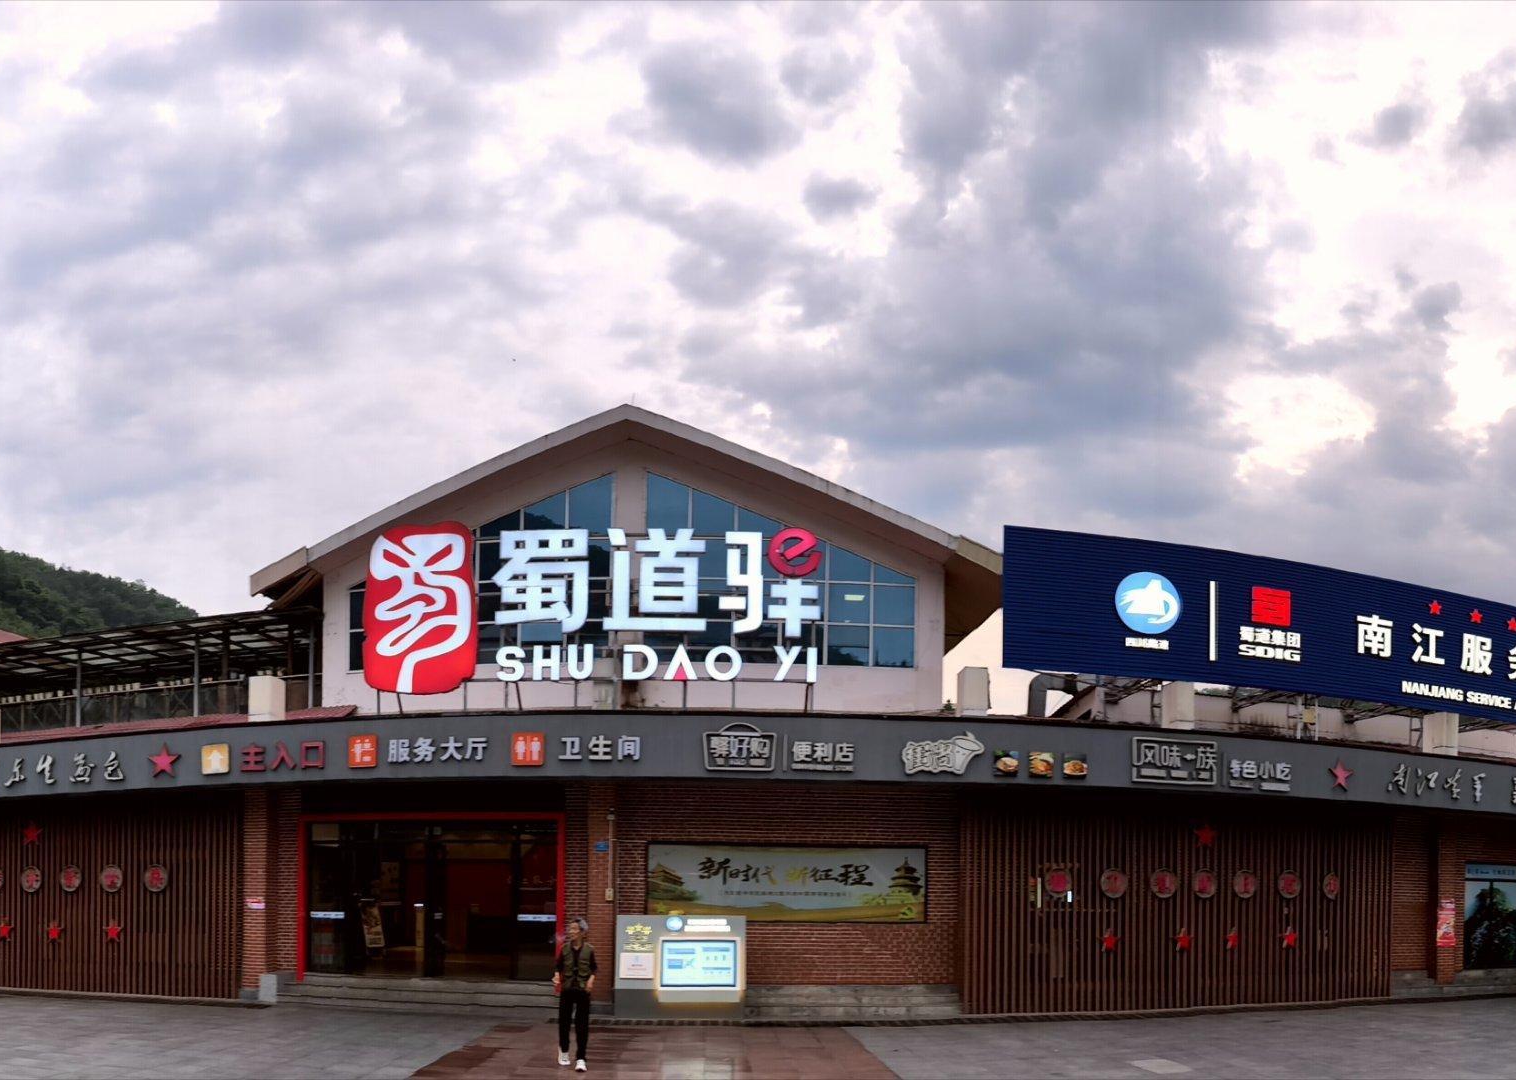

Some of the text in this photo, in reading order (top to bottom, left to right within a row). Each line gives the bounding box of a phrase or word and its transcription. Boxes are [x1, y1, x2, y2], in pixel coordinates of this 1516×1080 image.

[492, 527, 822, 638] 蜀道驿
[1239, 626, 1301, 649] 蜀道集团
[495, 643, 818, 684] SHU DAO YI
[1238, 644, 1301, 662] SDIG
[1401, 680, 1464, 702] NANJIANG
[1466, 690, 1512, 710] SERVICE
[240, 740, 326, 772] 主入口
[387, 736, 487, 764] 服务大厅
[558, 735, 641, 761] 卫生间
[792, 741, 855, 763] 便利店
[1139, 743, 1216, 770] 风味一族
[1229, 759, 1293, 781] 特色小吃
[697, 856, 874, 887] 新时代 新征程
